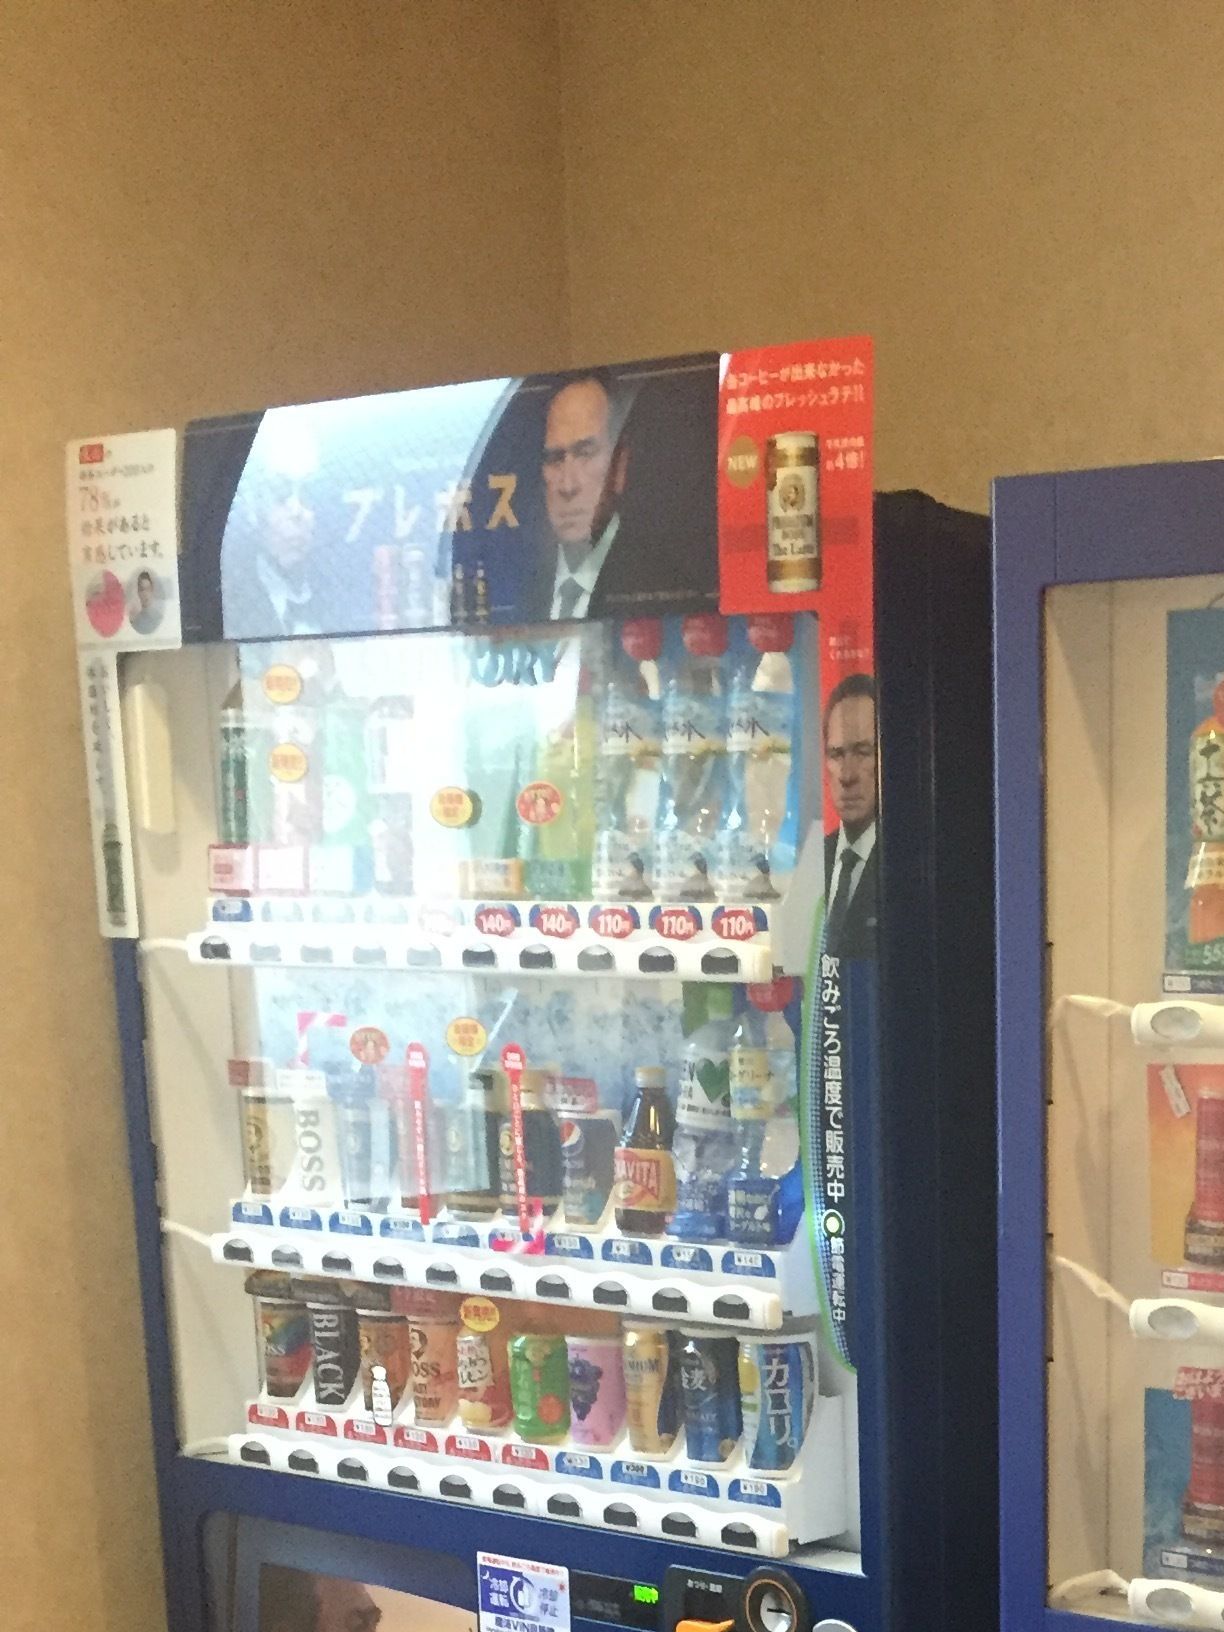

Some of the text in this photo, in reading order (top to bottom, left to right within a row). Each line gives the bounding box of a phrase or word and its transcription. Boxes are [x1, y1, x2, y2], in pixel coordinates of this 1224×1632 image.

[727, 454, 758, 472] NEW
[661, 913, 694, 936] 110円
[719, 914, 754, 937] 110円
[820, 953, 847, 1203] 飲みごろ温度で販売中
[298, 1108, 326, 1193] BOSS
[314, 1313, 346, 1402] BLACK
